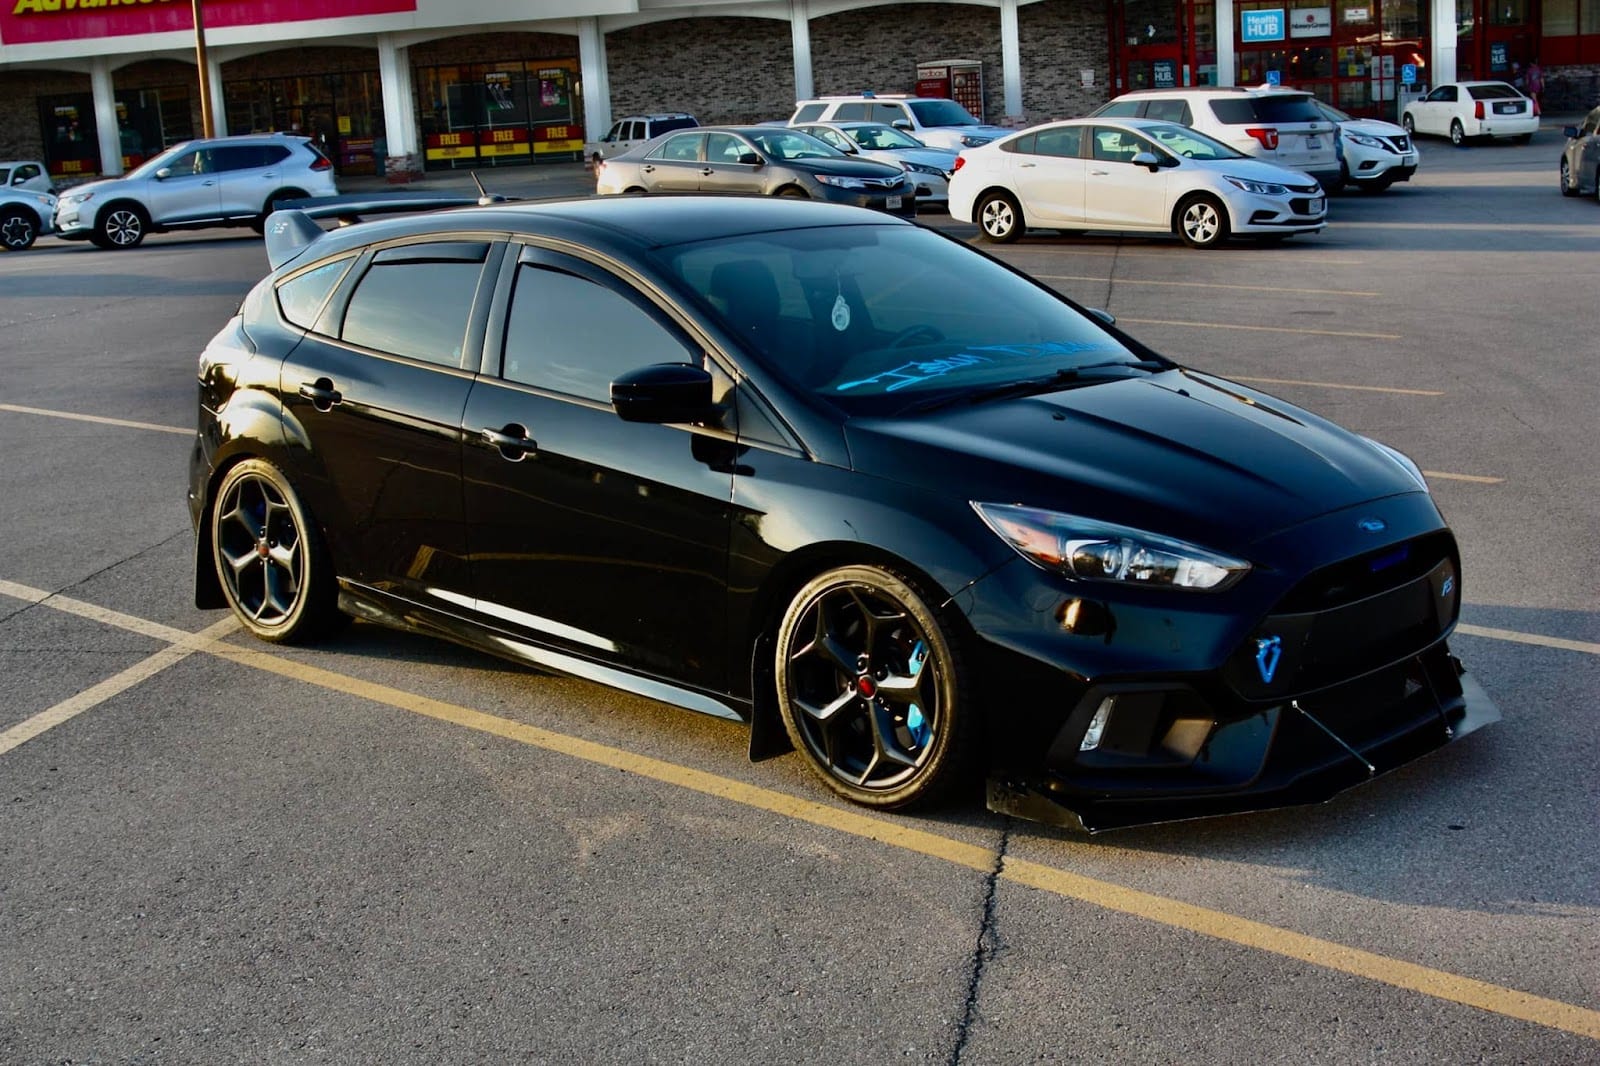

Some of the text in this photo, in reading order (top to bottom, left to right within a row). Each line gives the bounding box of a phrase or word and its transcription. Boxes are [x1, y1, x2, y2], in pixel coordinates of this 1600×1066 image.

[1247, 15, 1278, 25] Health
[1247, 24, 1279, 36] HUB
[493, 130, 515, 142] FREE
[546, 126, 568, 139] FREE
[440, 133, 461, 146] FREE
